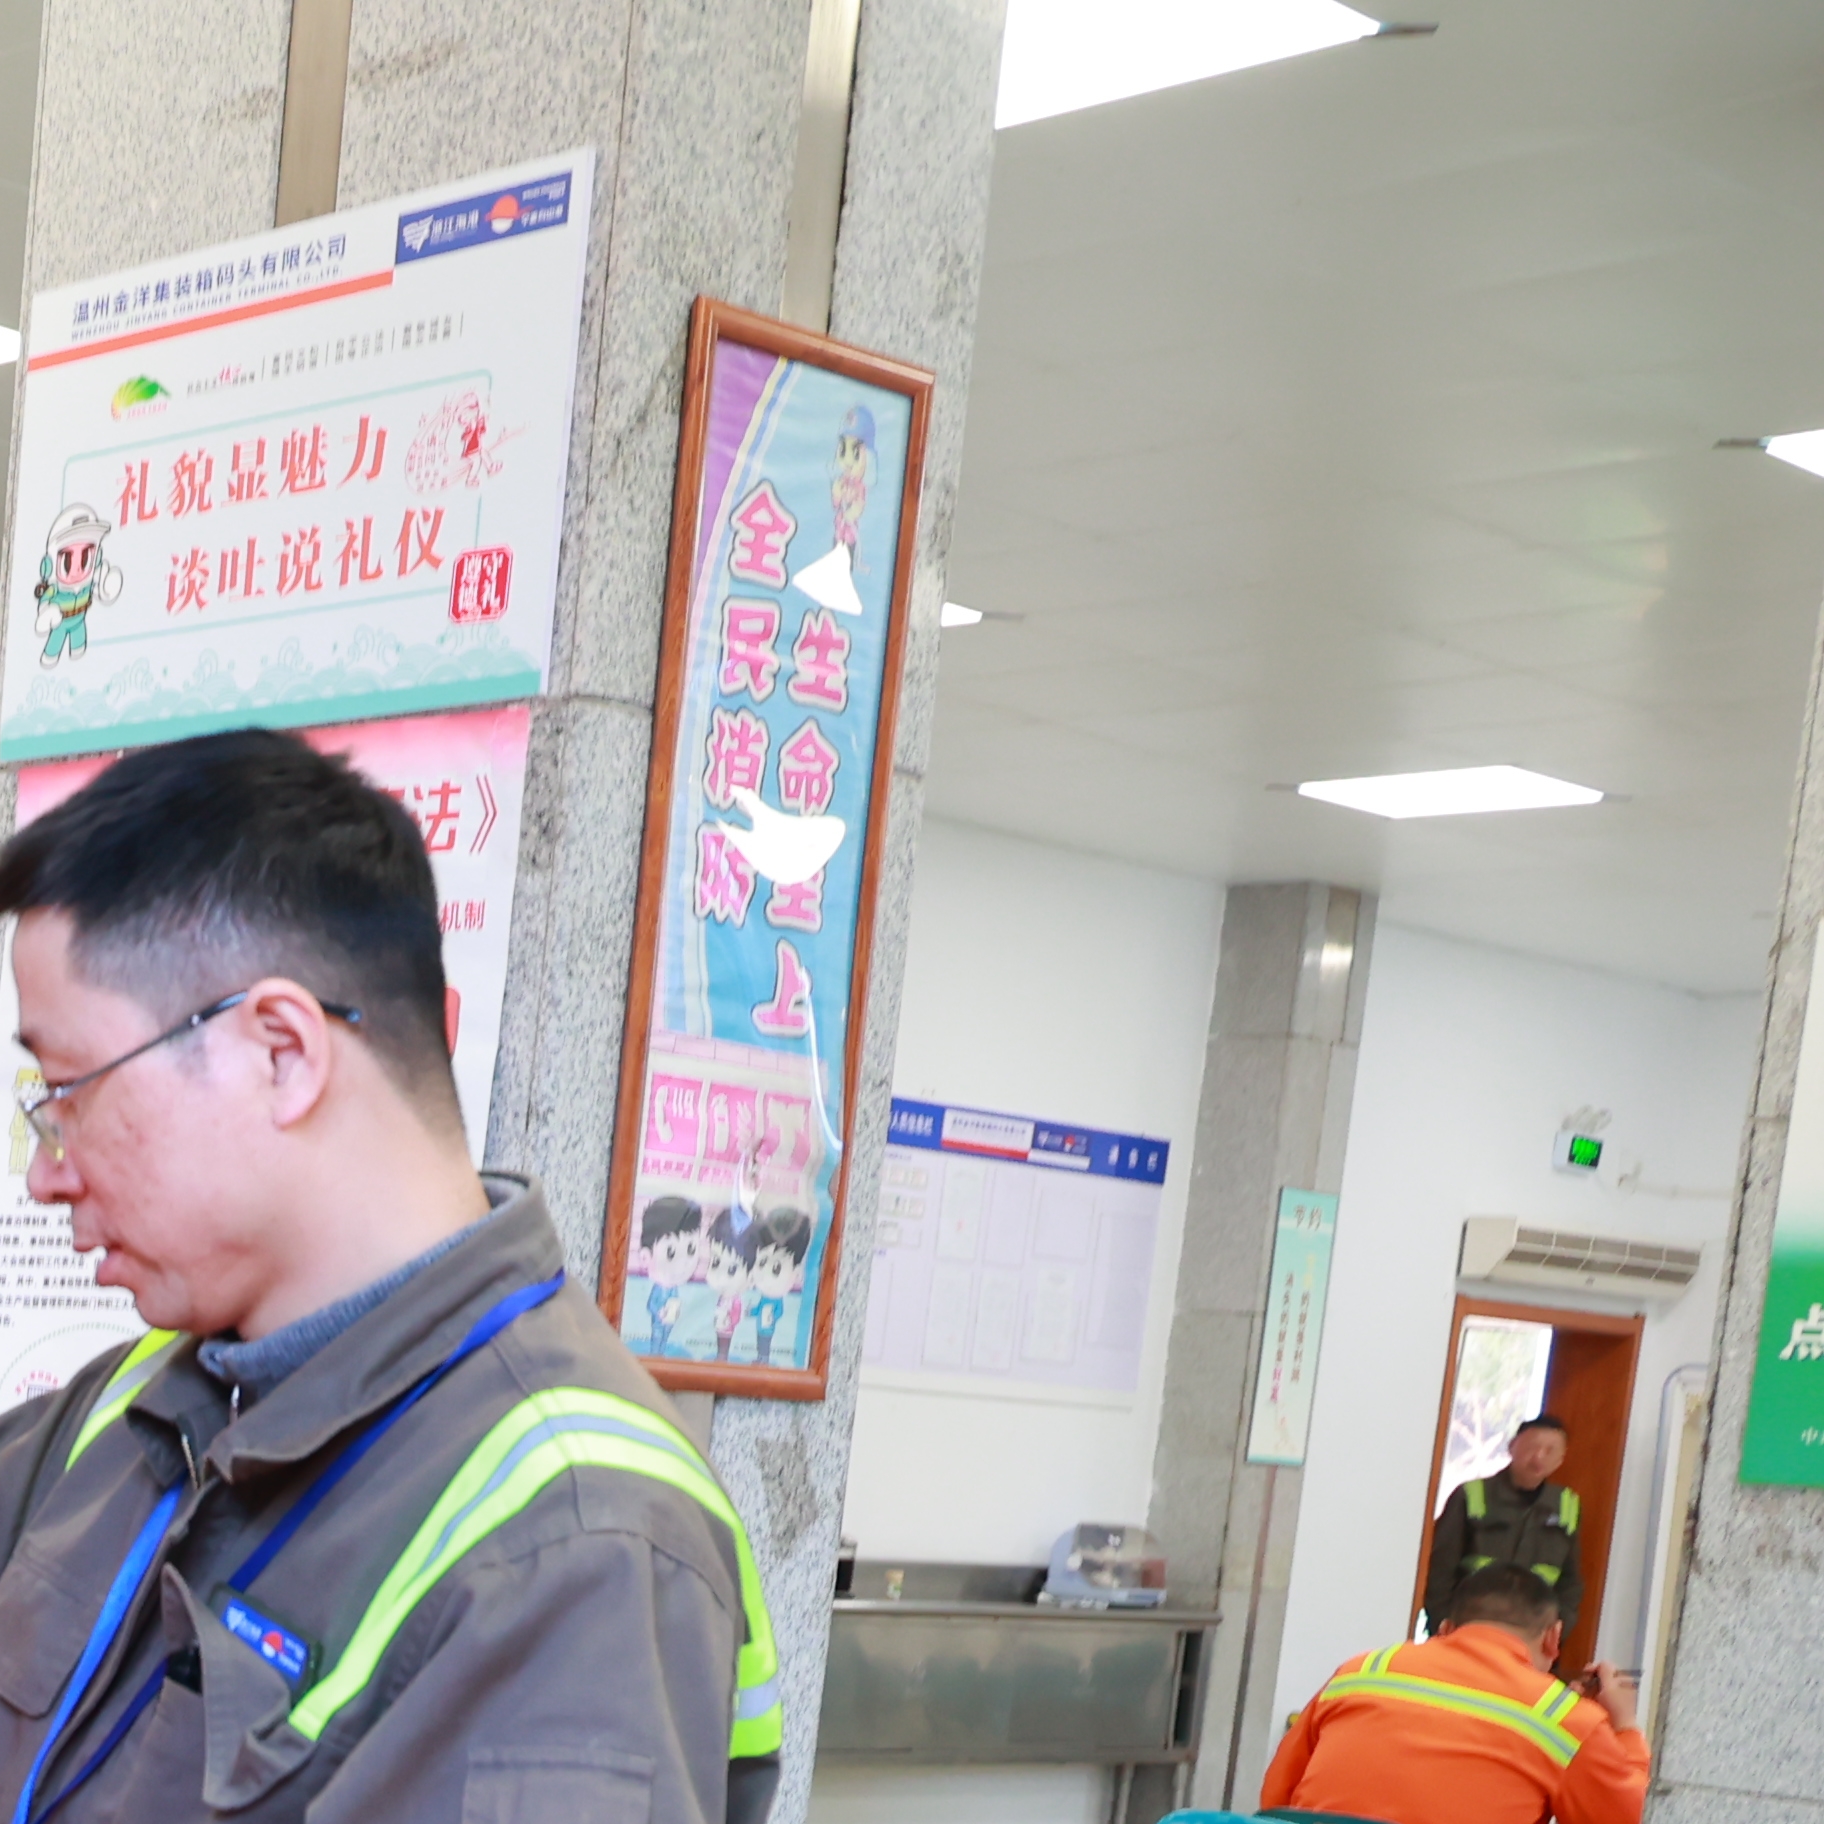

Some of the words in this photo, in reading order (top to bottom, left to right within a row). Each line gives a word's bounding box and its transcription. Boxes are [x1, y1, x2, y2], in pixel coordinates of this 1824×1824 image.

[72, 232, 347, 326] 温州金洋集装箱码头有限公司
[114, 414, 390, 528] 礼貌显魅力
[164, 505, 448, 616] 谈吐说礼仪
[378, 774, 498, 856] 法》
[438, 899, 487, 934] 机制
